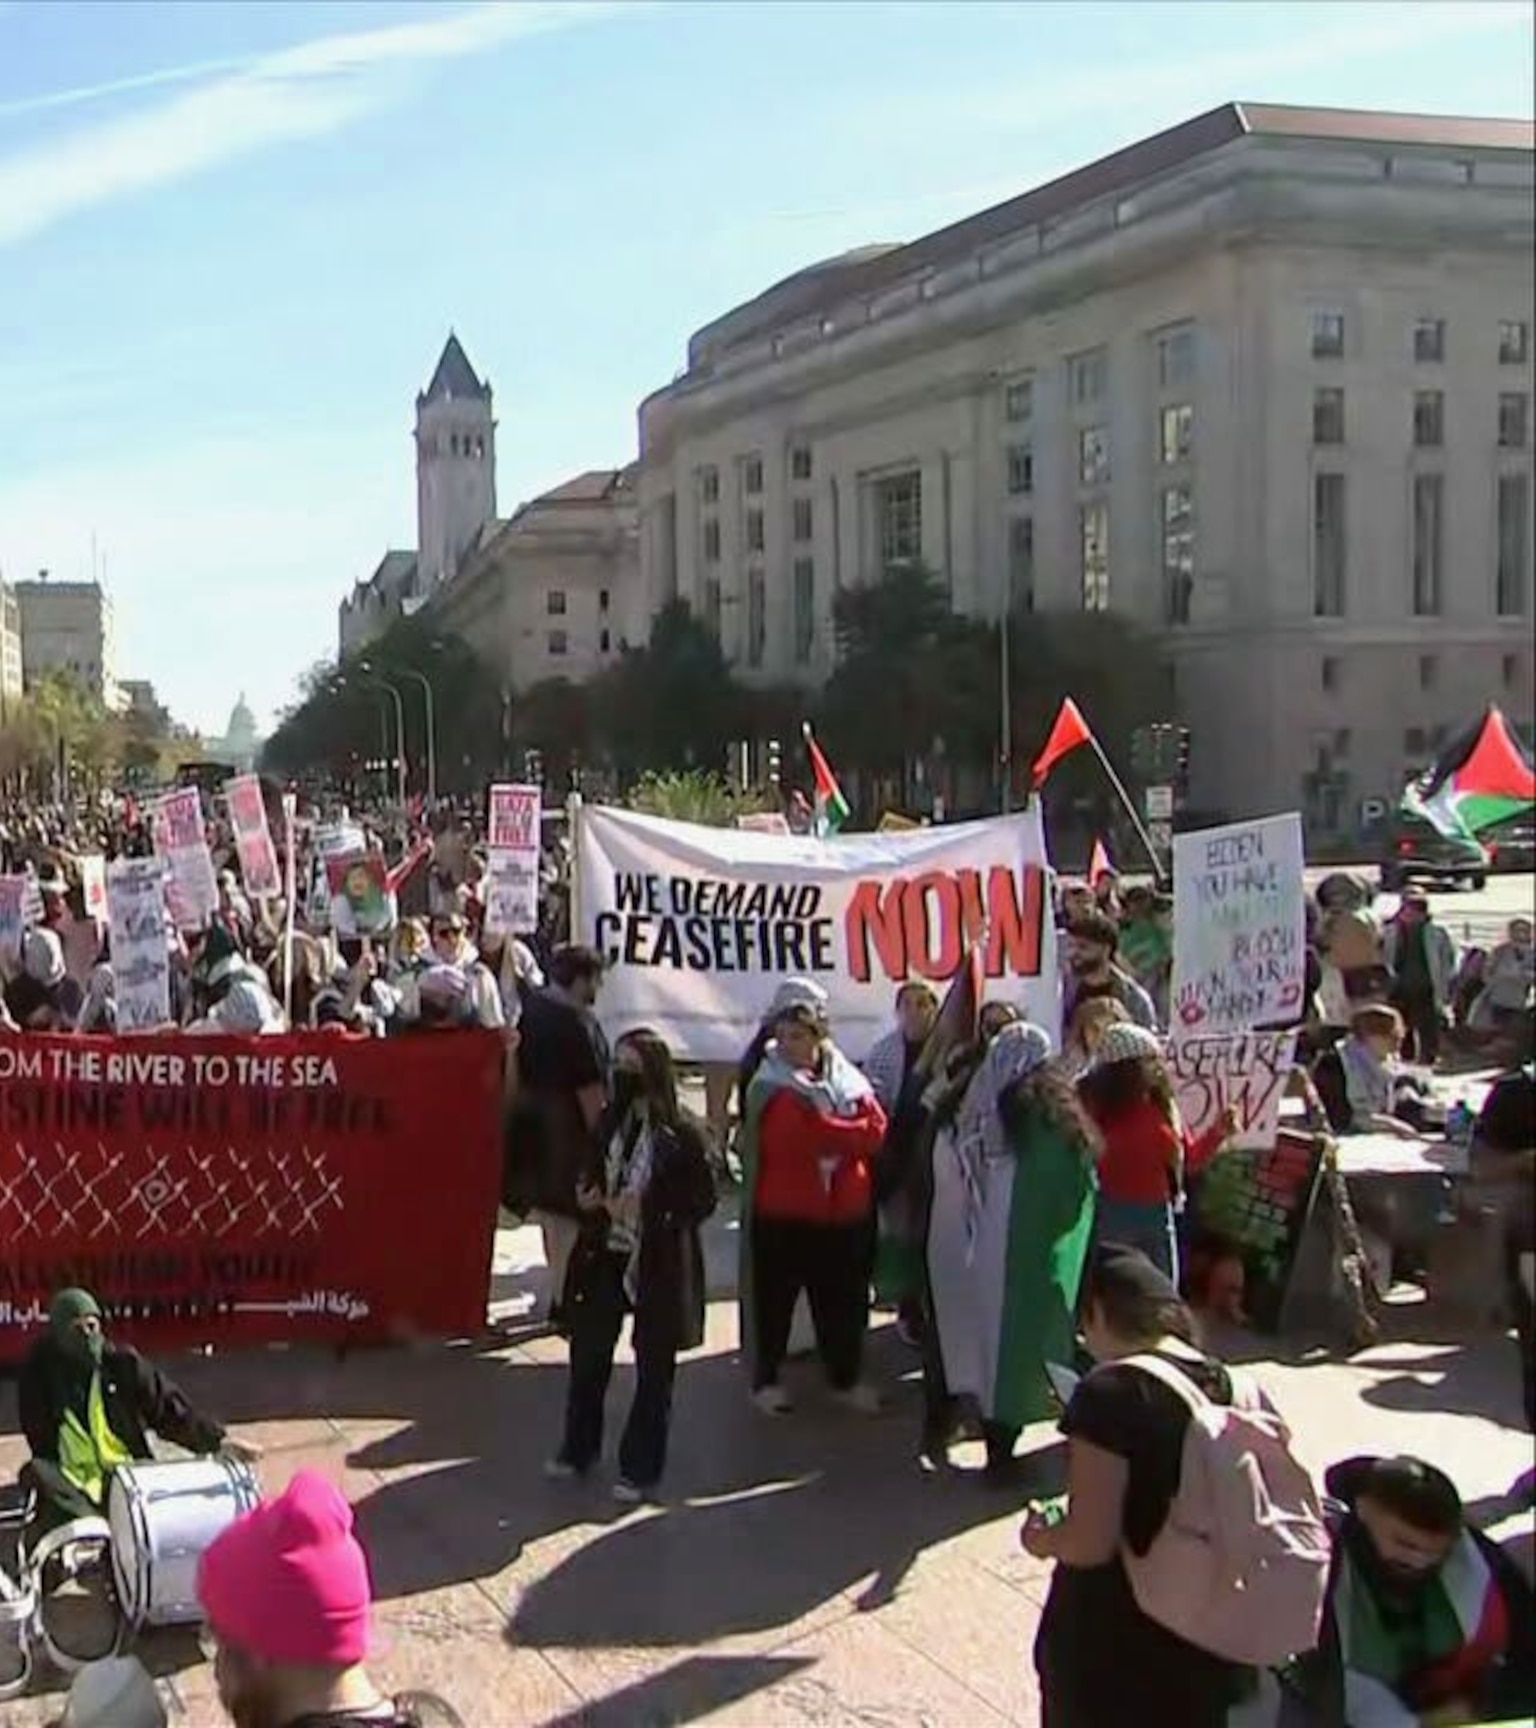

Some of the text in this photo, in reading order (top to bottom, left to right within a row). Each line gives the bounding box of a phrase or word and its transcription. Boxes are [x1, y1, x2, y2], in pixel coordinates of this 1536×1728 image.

[615, 874, 822, 918] WE DEMAND
[595, 913, 836, 973] CEASEFIRE
[846, 863, 1045, 984] NOW
[47, 1049, 101, 1082] THE
[105, 1053, 184, 1086] RIVER
[192, 1055, 229, 1086] TO
[234, 1055, 284, 1088] THE
[291, 1056, 338, 1087] SEA
